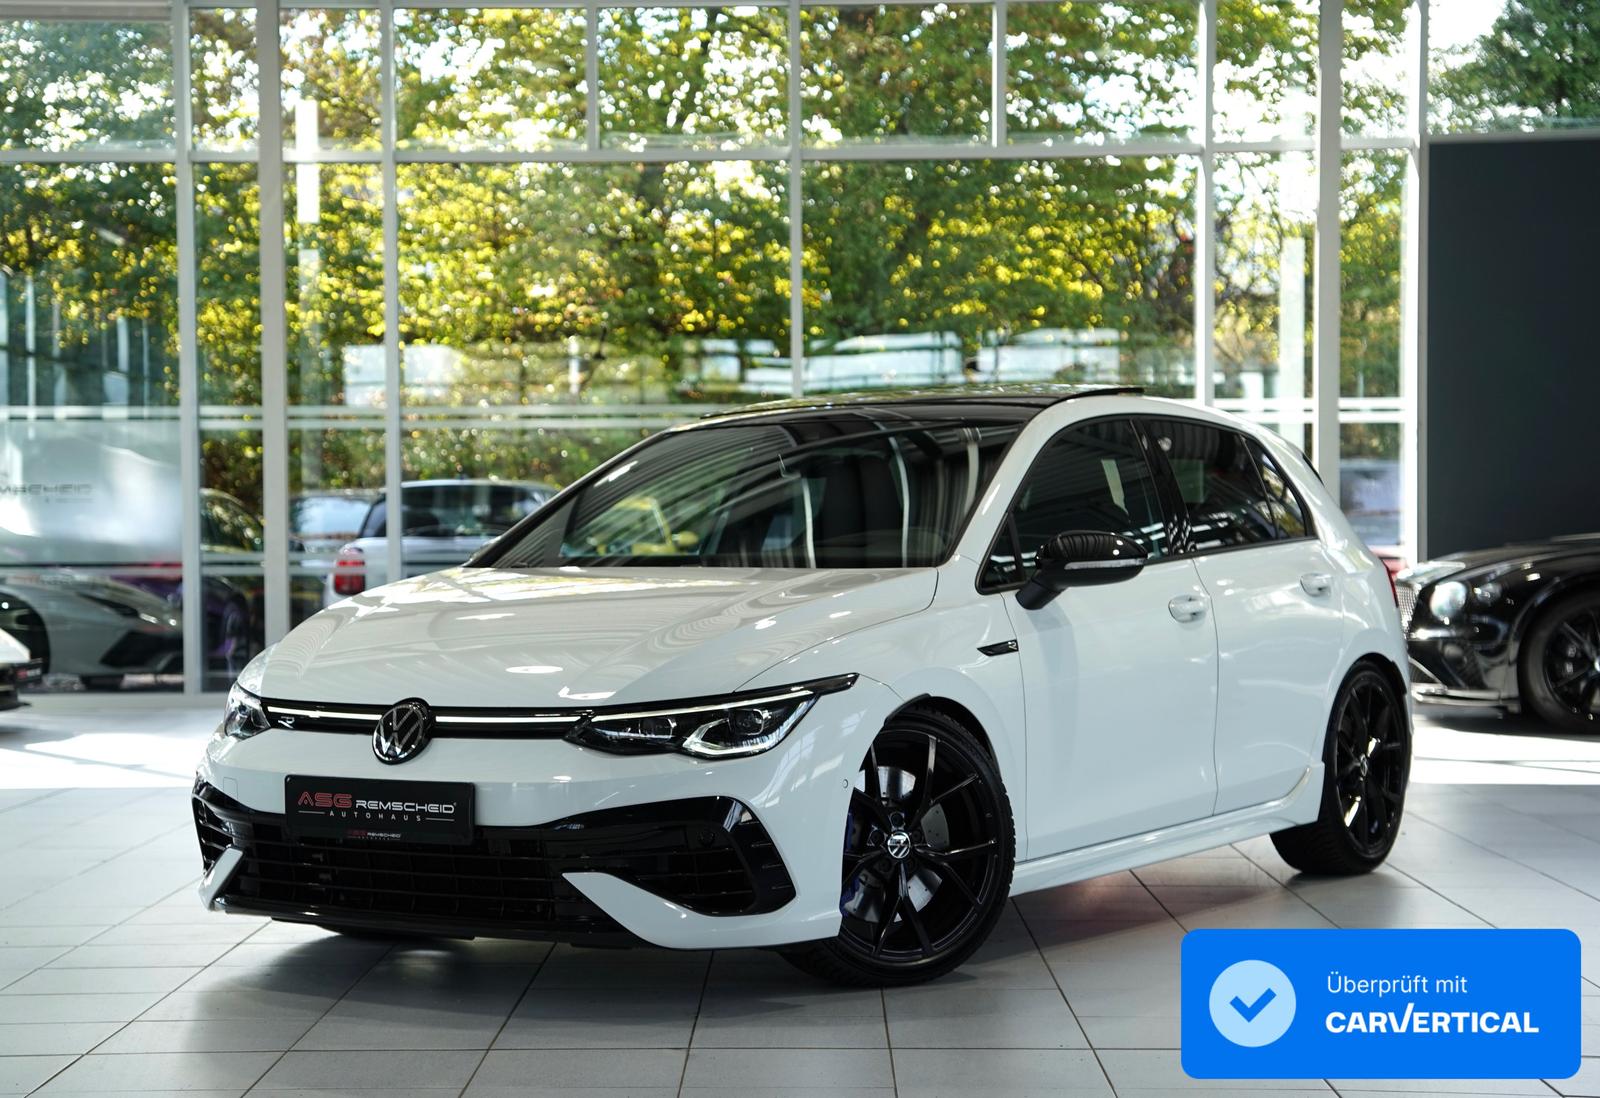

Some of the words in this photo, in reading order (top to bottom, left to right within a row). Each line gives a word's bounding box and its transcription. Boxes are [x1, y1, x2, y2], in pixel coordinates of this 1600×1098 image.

[297, 791, 352, 808] ASG
[355, 800, 455, 813] REMSCHEID
[329, 811, 421, 822] AUTOHAUS
